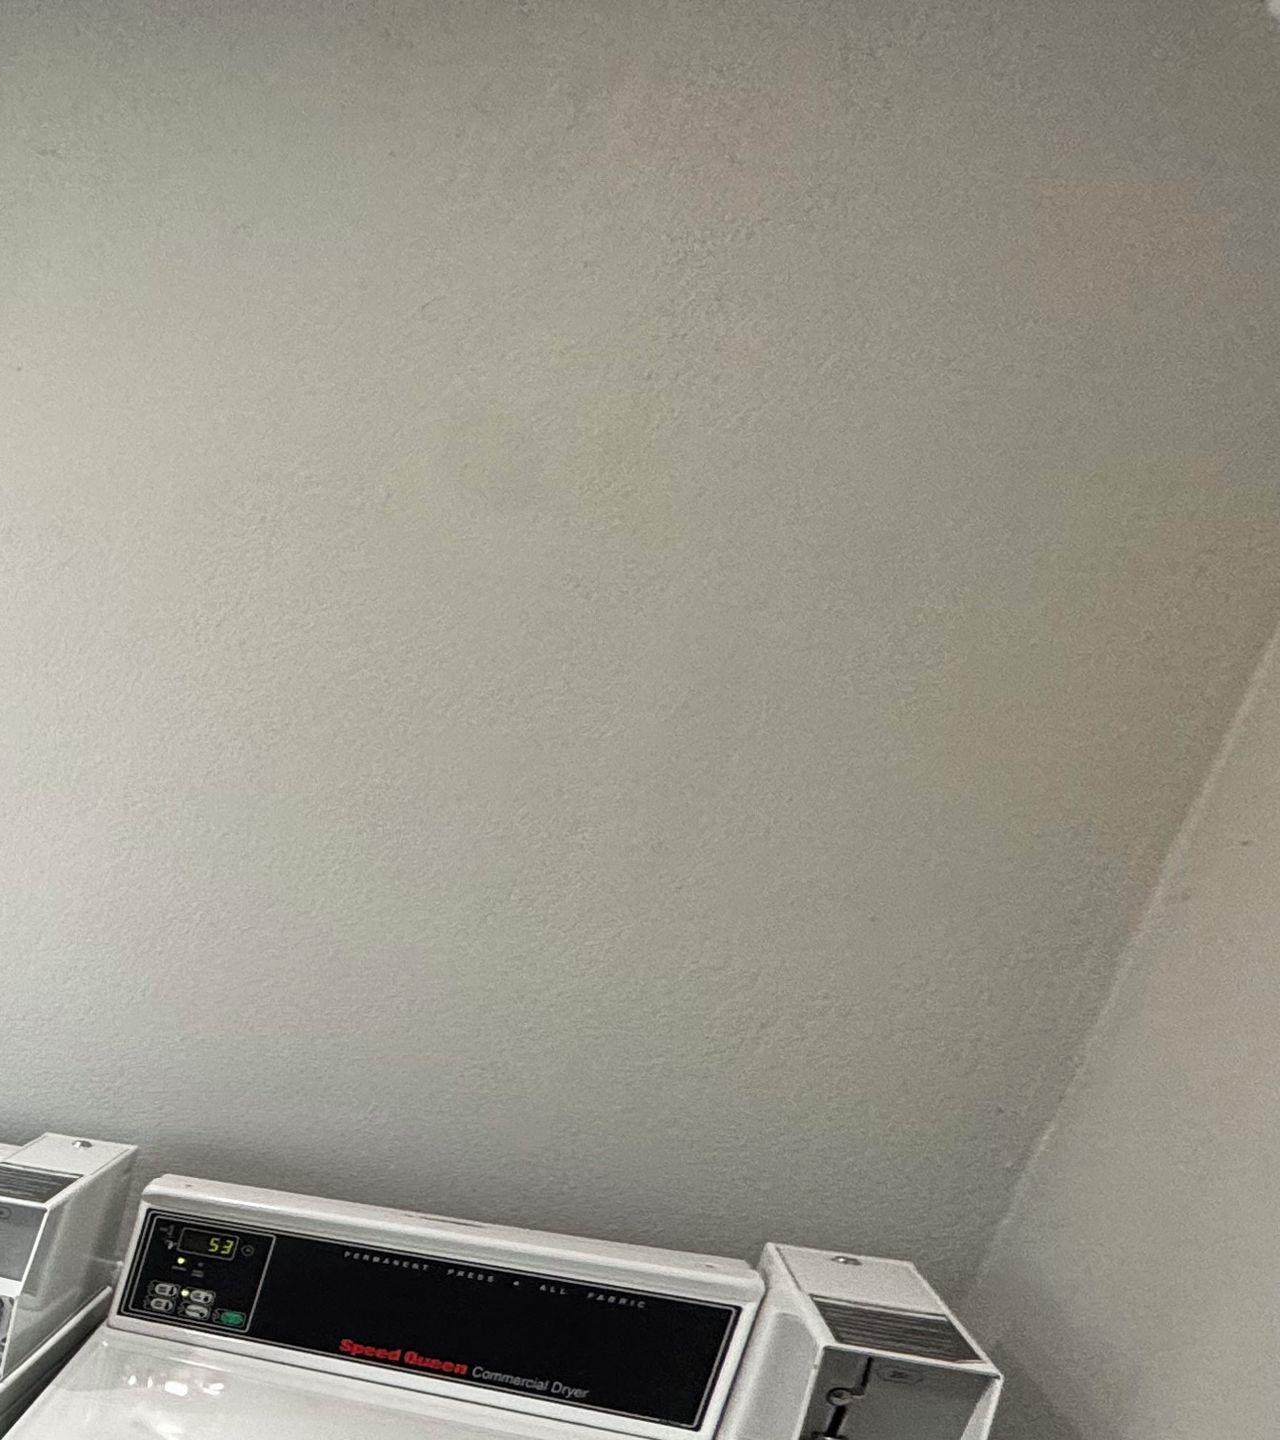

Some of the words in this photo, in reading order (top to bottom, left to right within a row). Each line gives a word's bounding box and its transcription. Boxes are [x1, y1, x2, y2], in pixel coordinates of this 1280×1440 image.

[208, 1237, 234, 1254] 53
[540, 1284, 567, 1295] ALL
[340, 1339, 401, 1360] Speed
[404, 1351, 468, 1375] Queen
[471, 1366, 549, 1391] Commercial
[551, 1381, 590, 1399] Dryer
